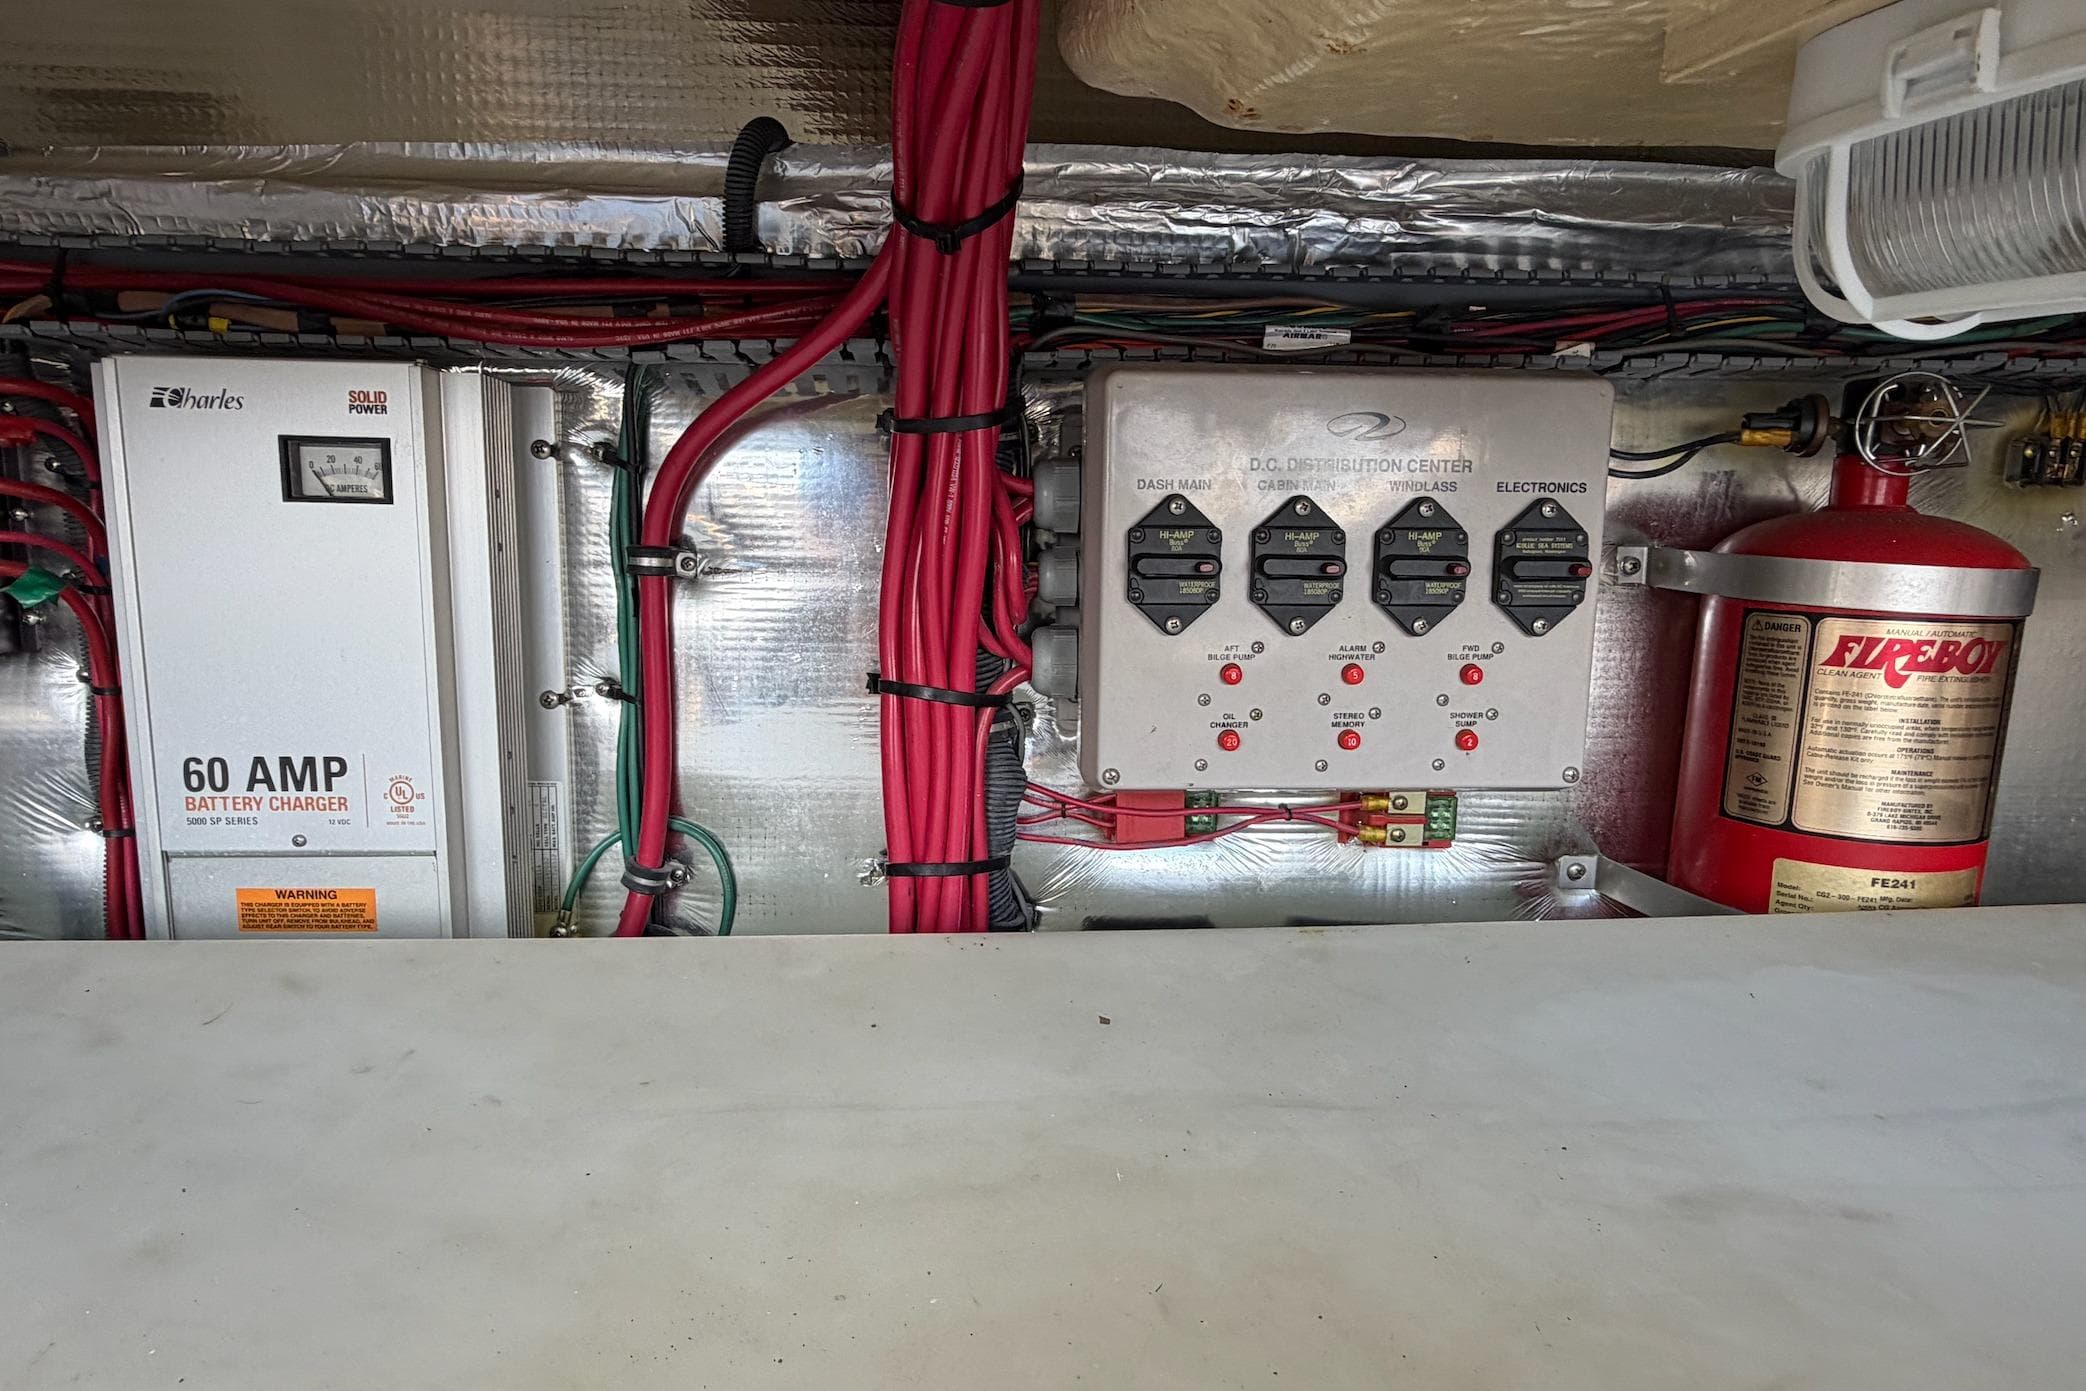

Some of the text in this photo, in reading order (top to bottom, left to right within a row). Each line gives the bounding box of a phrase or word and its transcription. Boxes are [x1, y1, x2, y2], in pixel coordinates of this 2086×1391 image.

[160, 386, 244, 411] Charles
[348, 390, 388, 404] SOLID
[348, 404, 388, 415] POWER
[326, 454, 336, 464] 20
[353, 455, 364, 466] 40
[1250, 458, 1473, 474] D.C. DISTRIBUTION CENTER
[336, 484, 368, 494] AMPERES
[1136, 479, 1212, 491] DASH MAIN
[1258, 480, 1337, 492] CABIN MAIN
[1389, 480, 1458, 493] WINDLASS
[1496, 482, 1588, 494] ELECTRONICS
[1160, 530, 1195, 539] HI-AMP
[1284, 532, 1320, 541] HI-AMP
[1408, 532, 1443, 541] HI-AMP
[1764, 622, 1802, 632] DANGER
[1886, 629, 1924, 638] MANUAL
[1818, 635, 2008, 689] FIREBOY
[1353, 672, 1358, 680] 5
[1816, 668, 1849, 678] CLEAN
[1851, 671, 1883, 680] AGENT
[182, 756, 348, 792] 60 AMP
[388, 774, 412, 782] MARINE
[395, 786, 408, 800] UL
[185, 796, 348, 812] BATTERY CHARGER
[186, 816, 208, 826] 5000
[210, 816, 222, 826] SP
[225, 816, 258, 826] SERIES
[1777, 882, 1800, 890] Model:
[1870, 878, 1916, 889] FE241
[274, 890, 338, 900] WARNING
[1776, 890, 1796, 899] Serial
